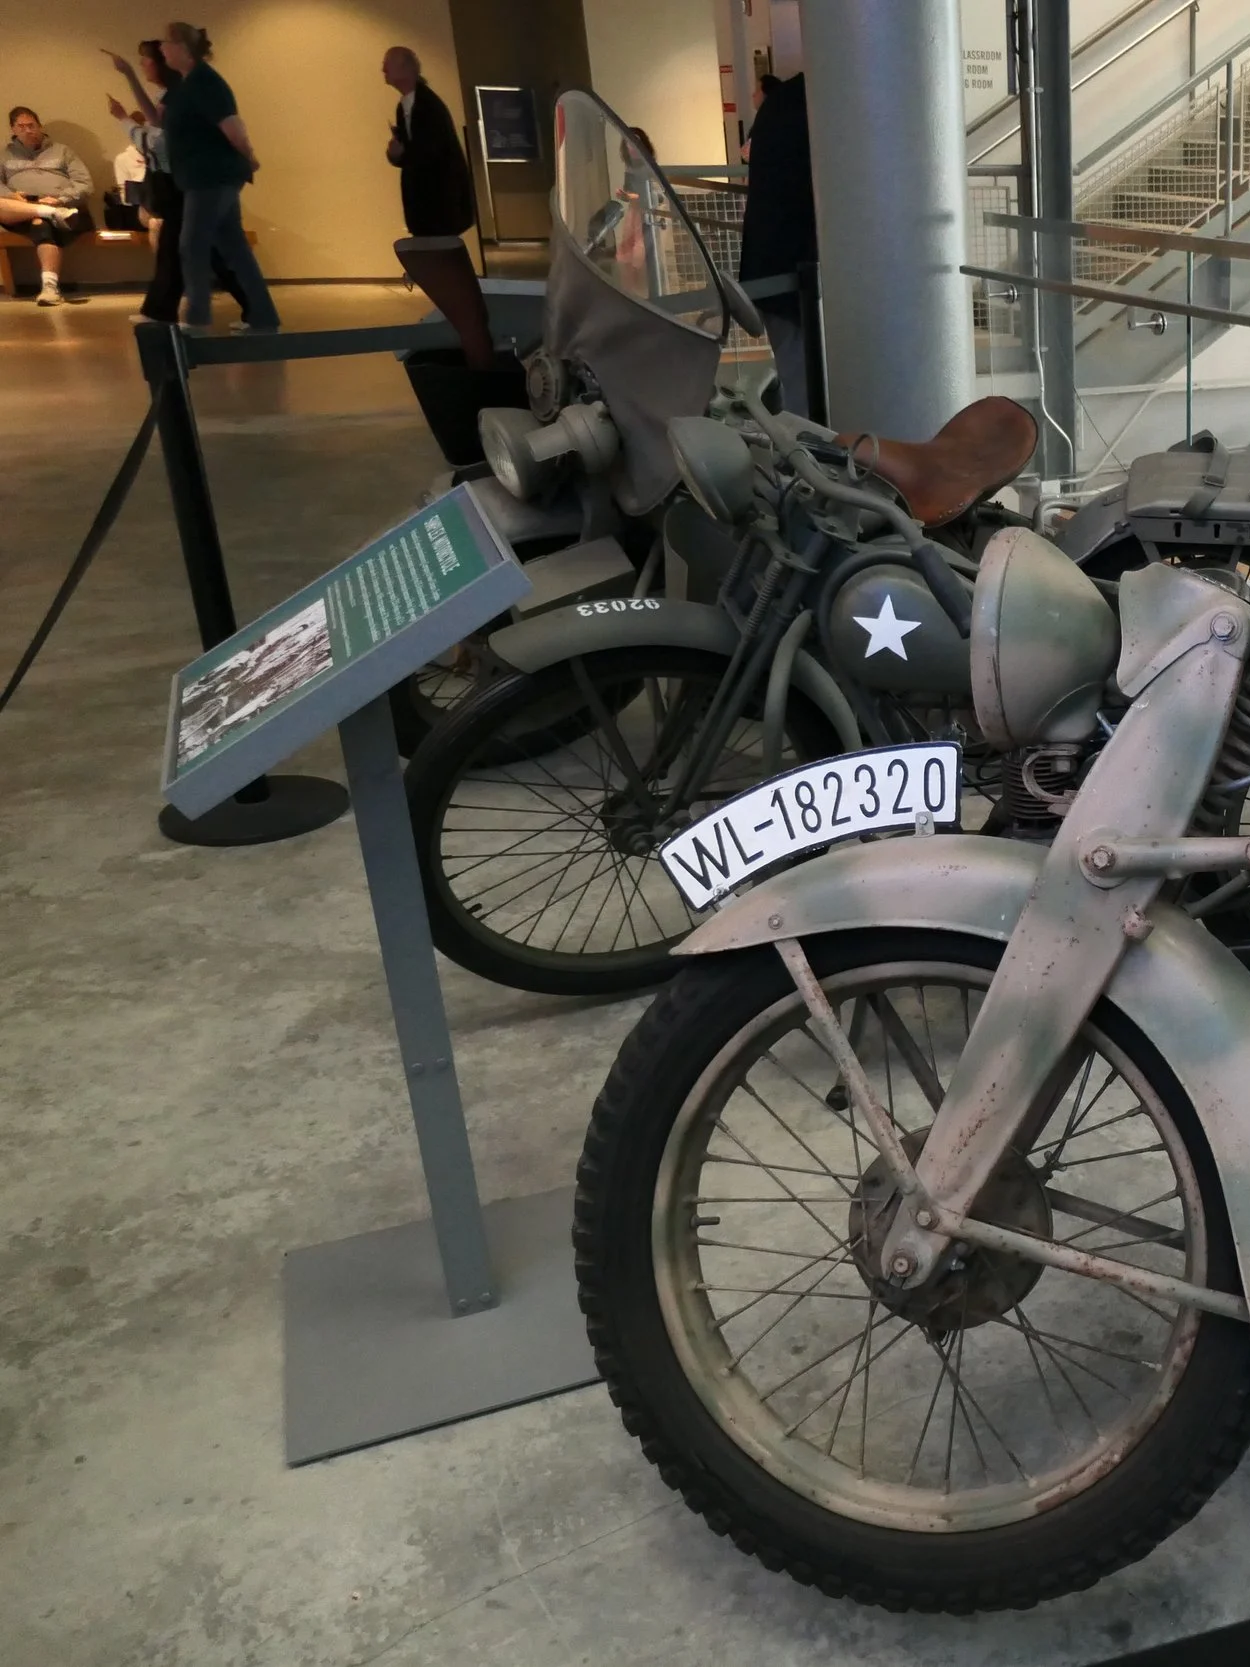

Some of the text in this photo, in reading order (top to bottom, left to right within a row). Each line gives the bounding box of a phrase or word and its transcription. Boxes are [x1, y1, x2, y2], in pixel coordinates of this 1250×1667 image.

[962, 50, 1002, 60] LASSROOM
[967, 65, 988, 75] ROOM
[971, 79, 993, 89] ROOM
[671, 757, 946, 891] WL-182320
